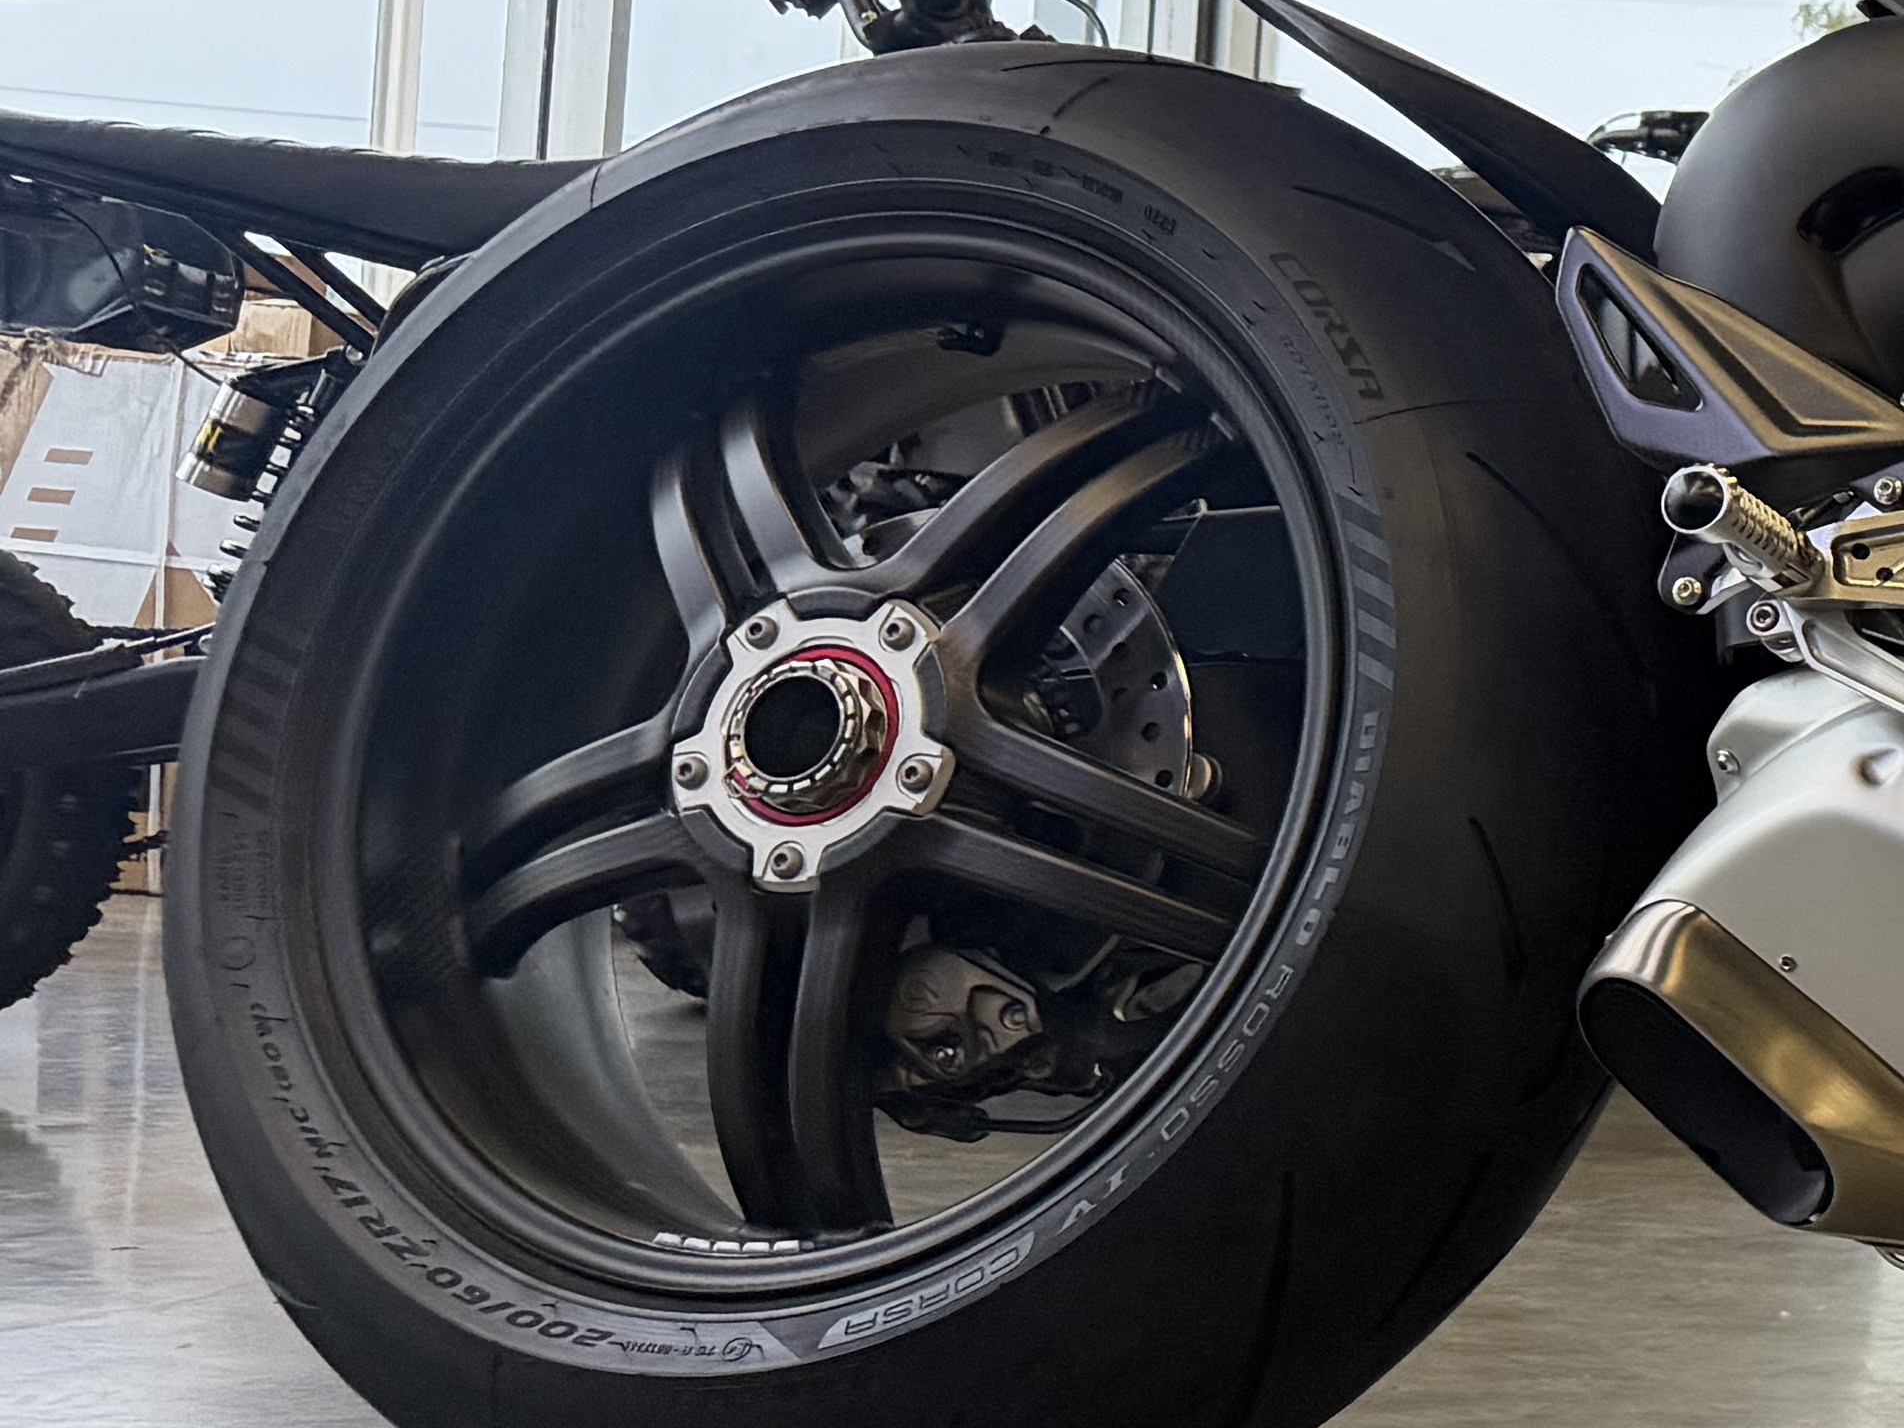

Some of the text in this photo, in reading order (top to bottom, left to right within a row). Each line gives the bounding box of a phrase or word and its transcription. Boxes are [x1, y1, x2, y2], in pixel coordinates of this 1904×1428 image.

[1294, 711, 1379, 950] DIABLO
[1159, 963, 1293, 1143] ROSSO
[843, 1244, 1024, 1337] CORSA
